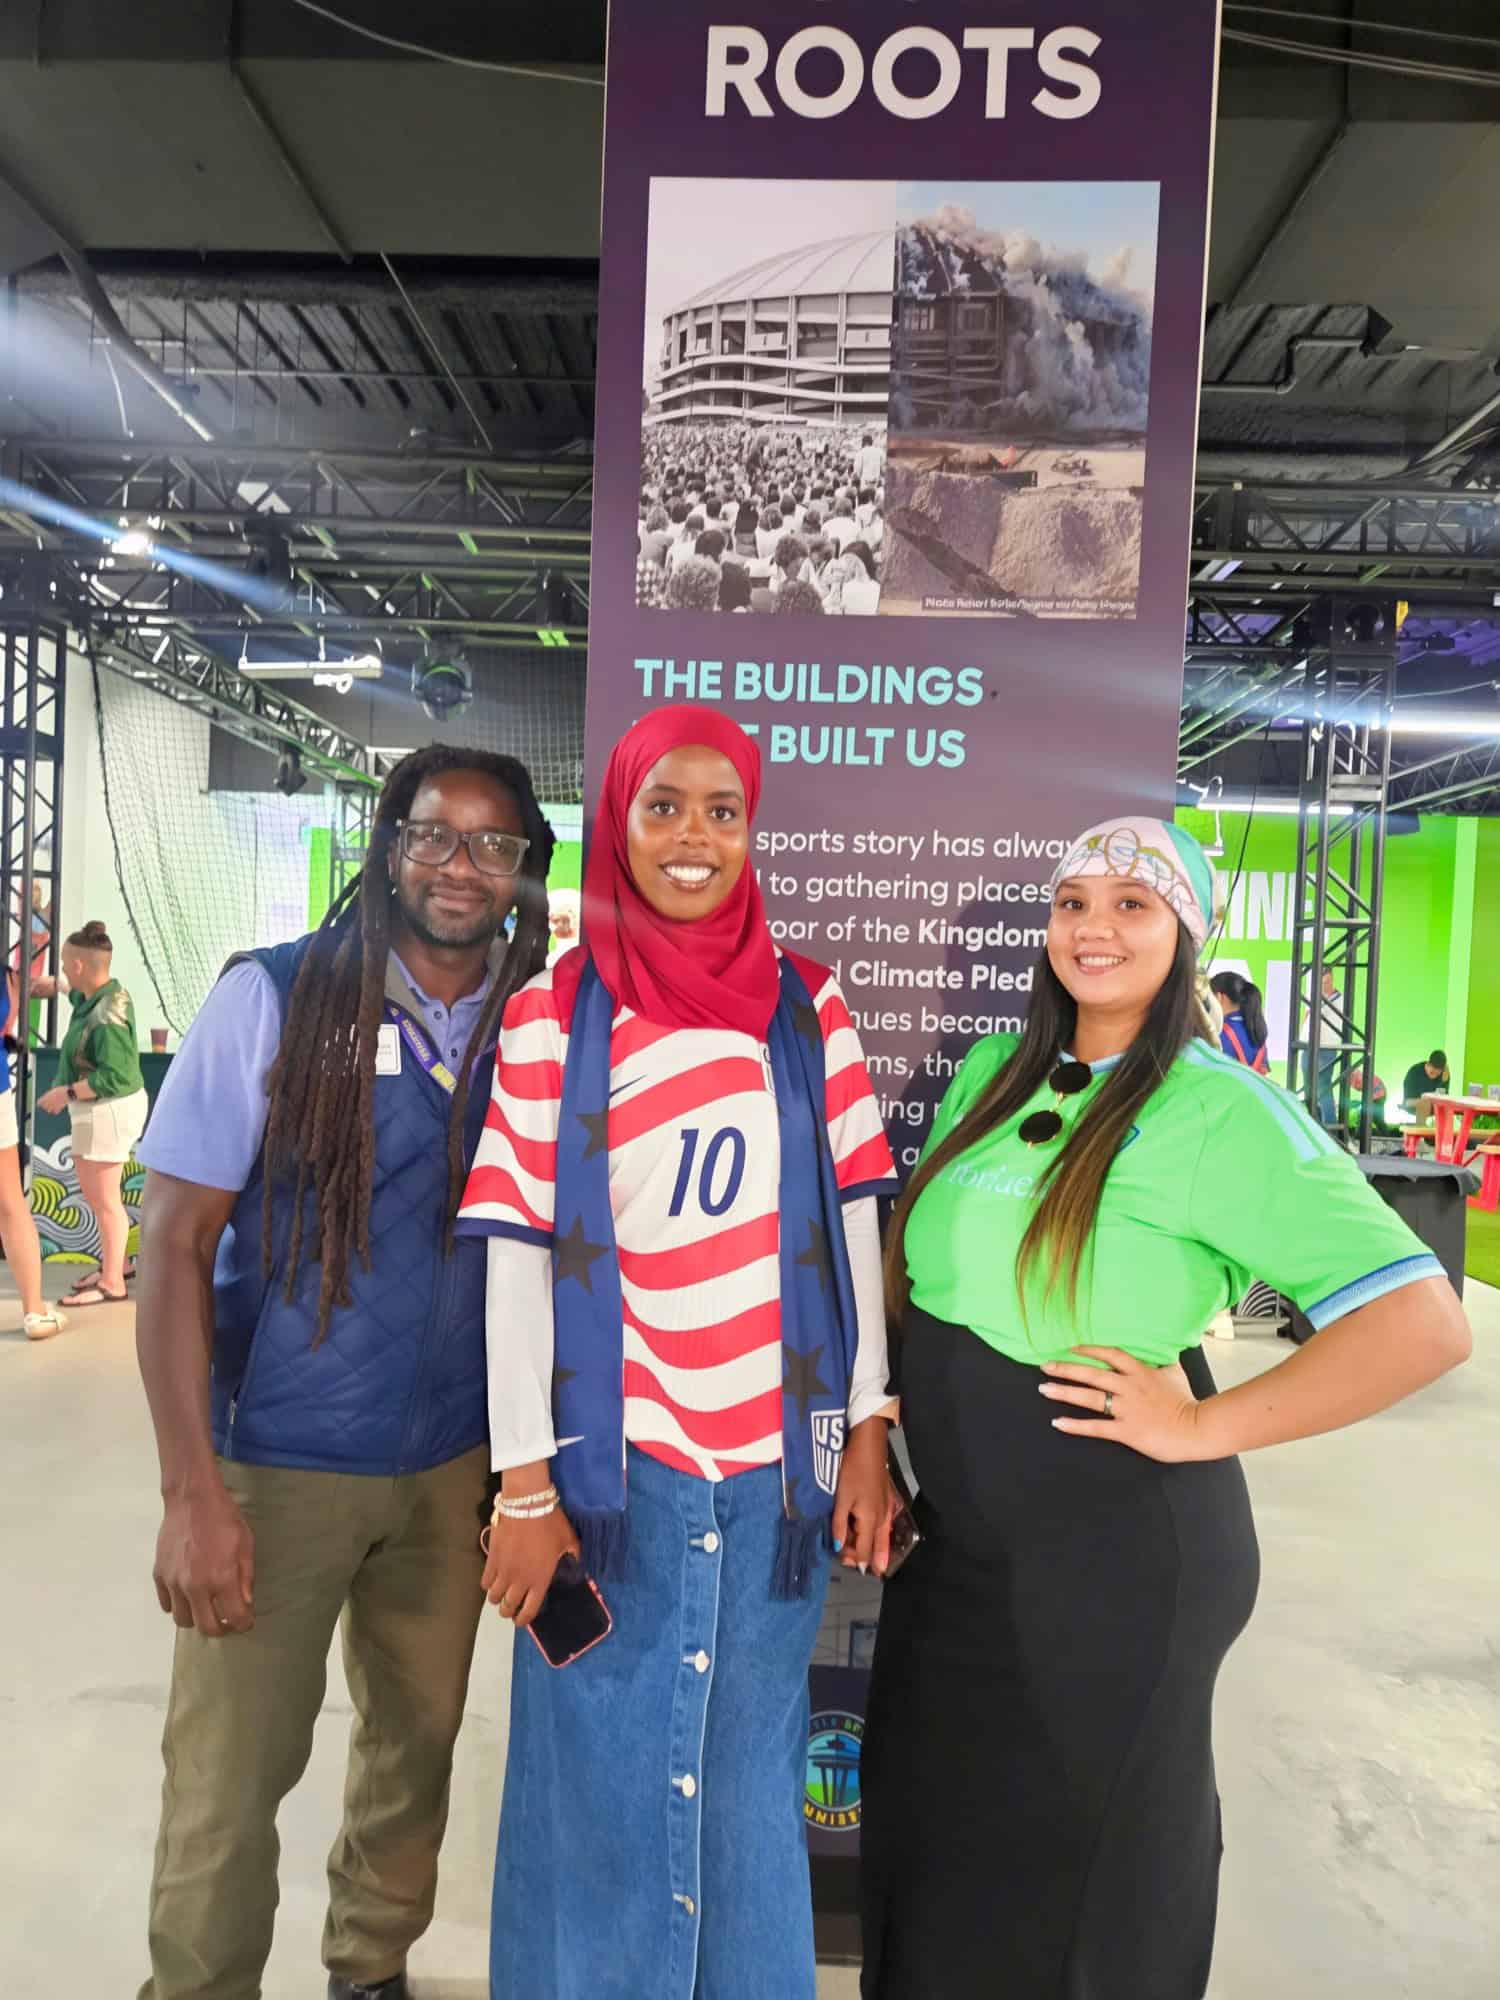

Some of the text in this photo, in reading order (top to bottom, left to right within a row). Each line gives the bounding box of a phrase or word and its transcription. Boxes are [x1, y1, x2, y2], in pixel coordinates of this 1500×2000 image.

[705, 25, 1102, 120] ROOTS
[635, 659, 984, 706] THE BUILDINGS
[769, 724, 966, 769] BUILT US
[756, 829, 845, 856] sports
[853, 831, 925, 861] story
[932, 830, 984, 857] has
[769, 873, 798, 896] to
[806, 872, 949, 905] gathering
[957, 875, 1050, 907] places
[826, 916, 856, 942] of
[863, 918, 910, 943] the
[918, 919, 1047, 951] Kingdom
[850, 961, 963, 989] Climate
[971, 965, 1034, 992] Pled
[668, 1126, 746, 1218] 10
[815, 1416, 844, 1451] US
